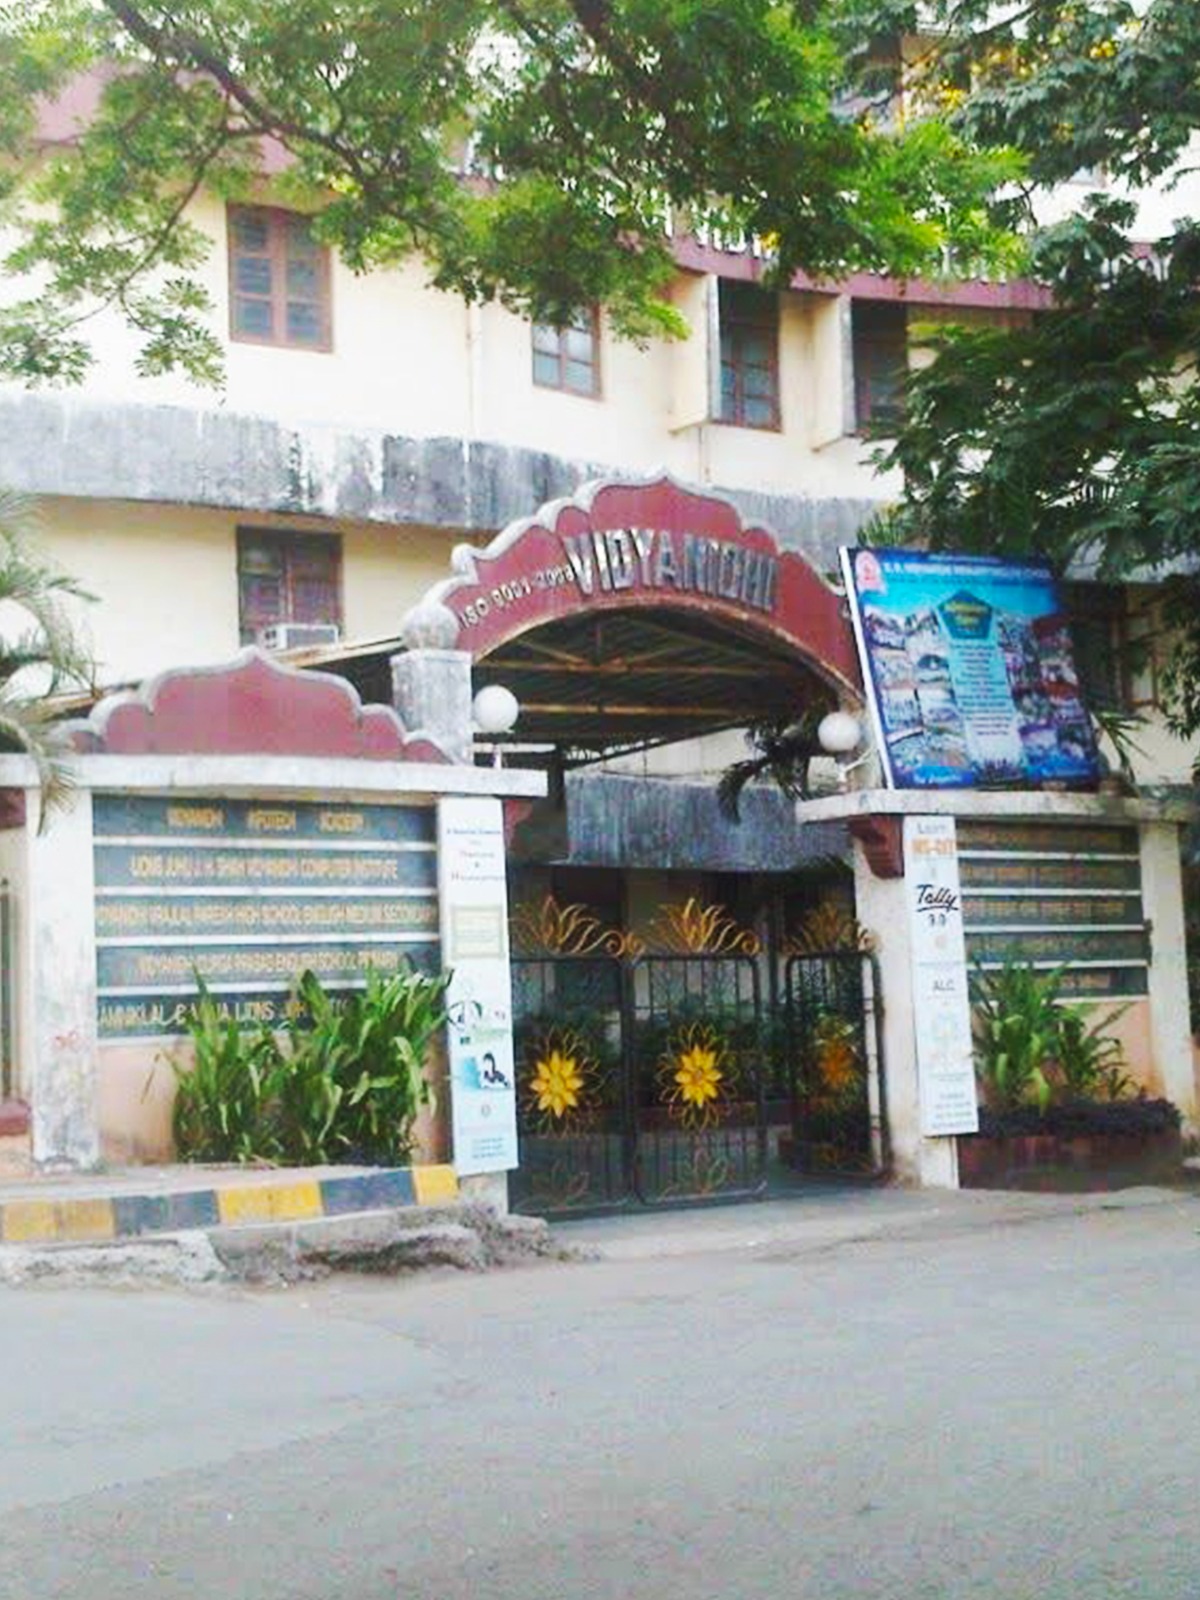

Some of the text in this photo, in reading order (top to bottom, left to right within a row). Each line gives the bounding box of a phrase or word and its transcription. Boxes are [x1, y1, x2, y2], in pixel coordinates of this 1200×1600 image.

[562, 526, 779, 612] VIDYANIDHI
[459, 597, 490, 629] ISO
[916, 884, 959, 912] Tally
